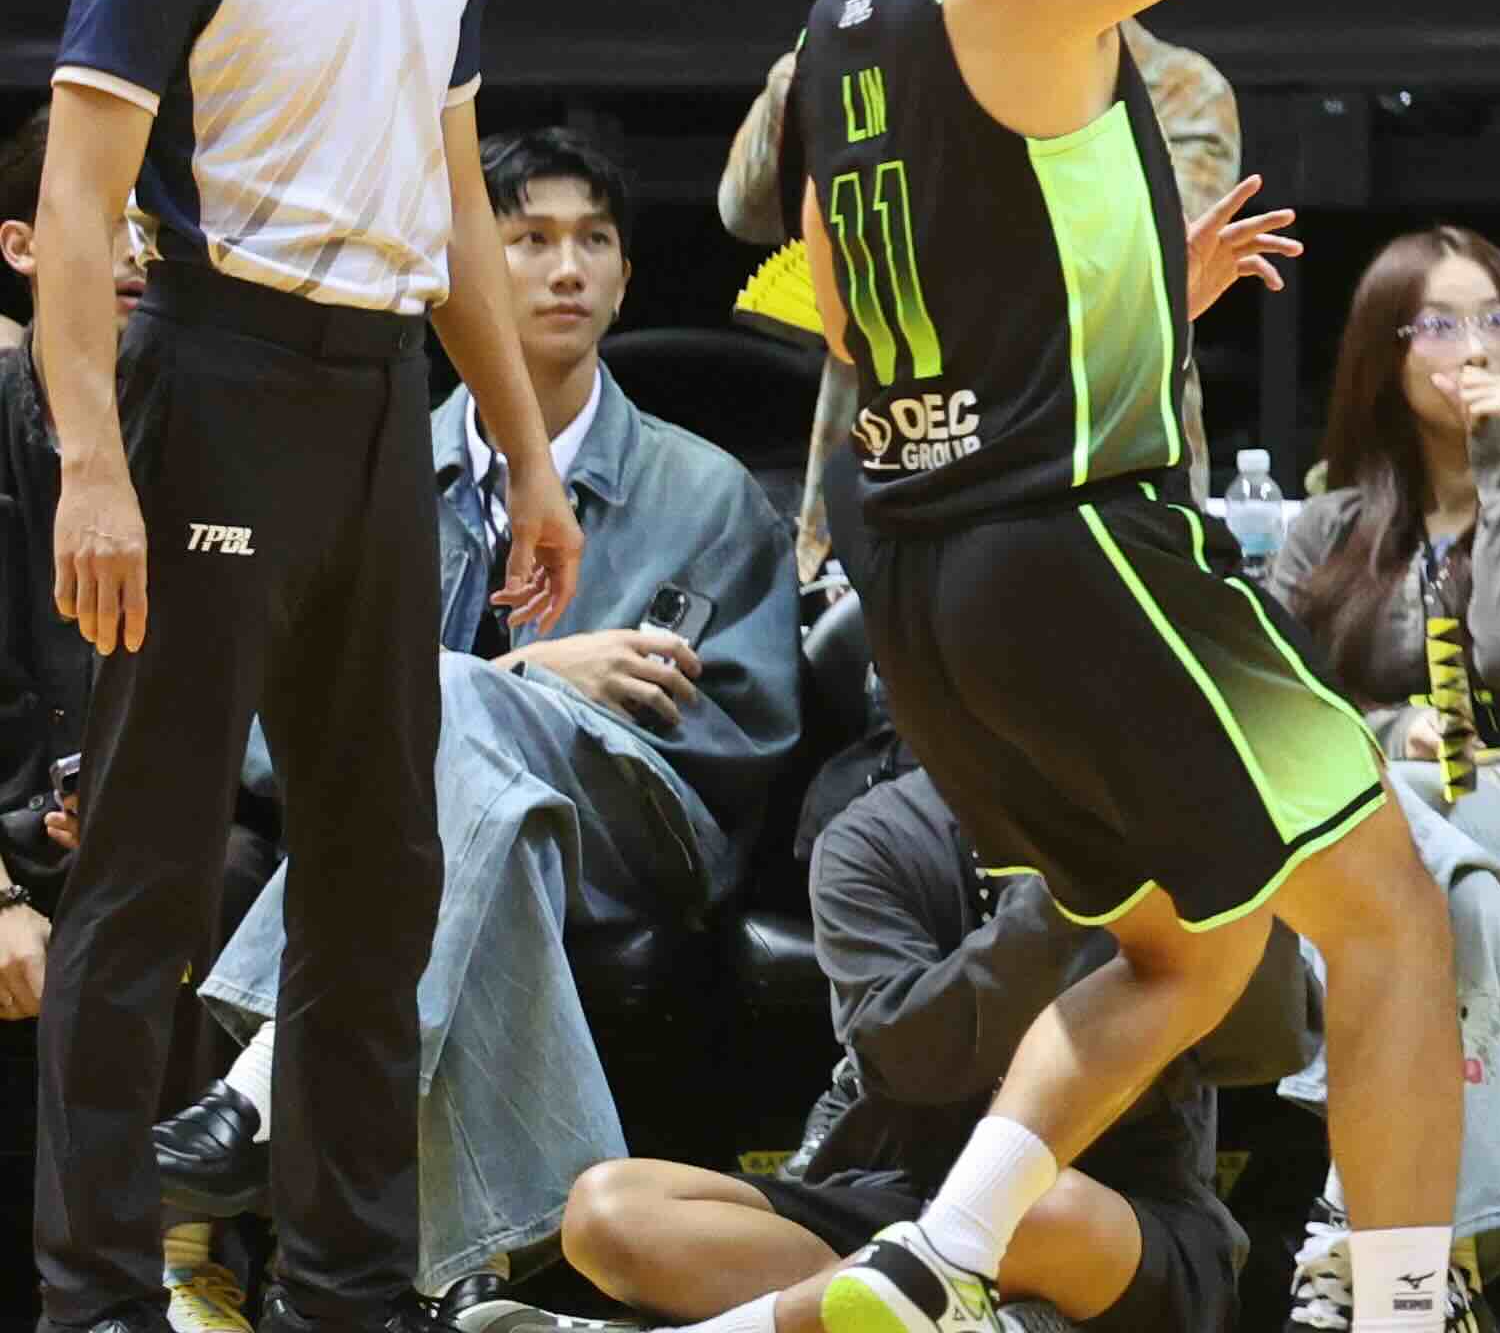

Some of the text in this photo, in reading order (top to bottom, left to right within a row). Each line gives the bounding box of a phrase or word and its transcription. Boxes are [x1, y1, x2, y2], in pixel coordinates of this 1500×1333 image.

[842, 66, 888, 143] LIN
[829, 159, 944, 386] 11
[890, 389, 981, 440] OEC
[187, 522, 256, 556] TPBL
